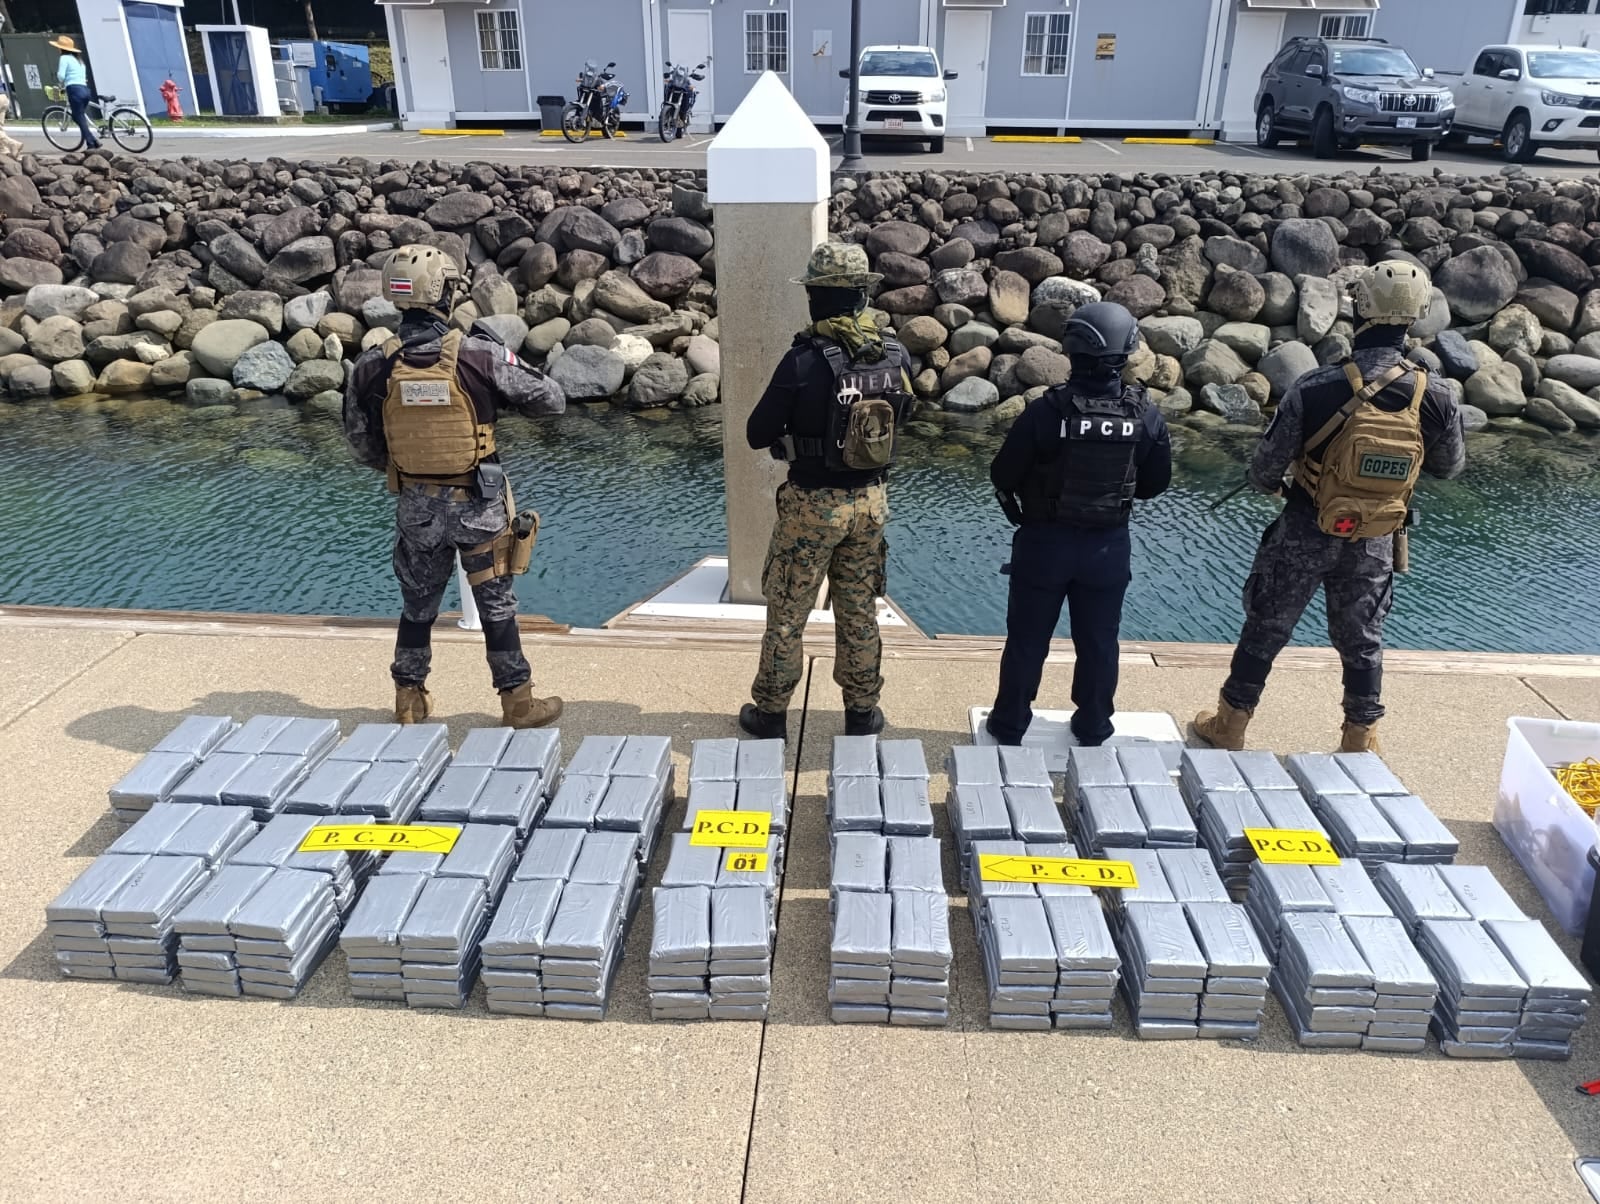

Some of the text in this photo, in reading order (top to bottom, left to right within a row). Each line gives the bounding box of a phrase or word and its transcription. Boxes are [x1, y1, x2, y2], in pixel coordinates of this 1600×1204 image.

[1363, 458, 1407, 476] GOPES
[697, 821, 766, 835] P.C.D.
[1254, 839, 1331, 853] P.C.D.
[733, 857, 757, 870] 01
